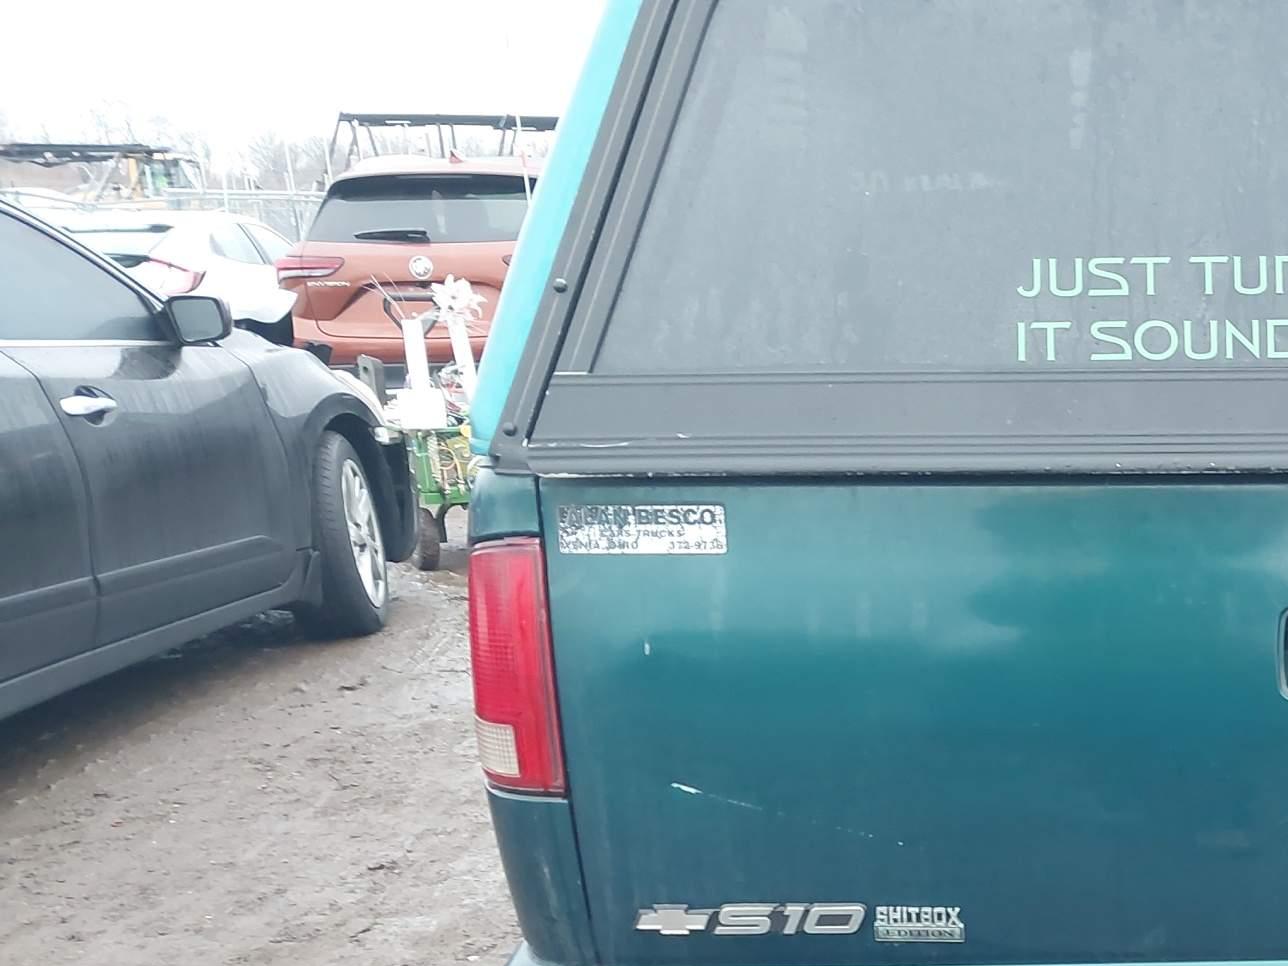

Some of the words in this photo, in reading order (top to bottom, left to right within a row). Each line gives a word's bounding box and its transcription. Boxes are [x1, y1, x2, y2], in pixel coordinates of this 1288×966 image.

[1016, 256, 1172, 298] JUST
[1016, 321, 1073, 362] IT
[635, 508, 715, 525] BESCO
[714, 902, 868, 935] S10
[875, 905, 964, 928] SHITBOX
[883, 929, 954, 938] EDITION
